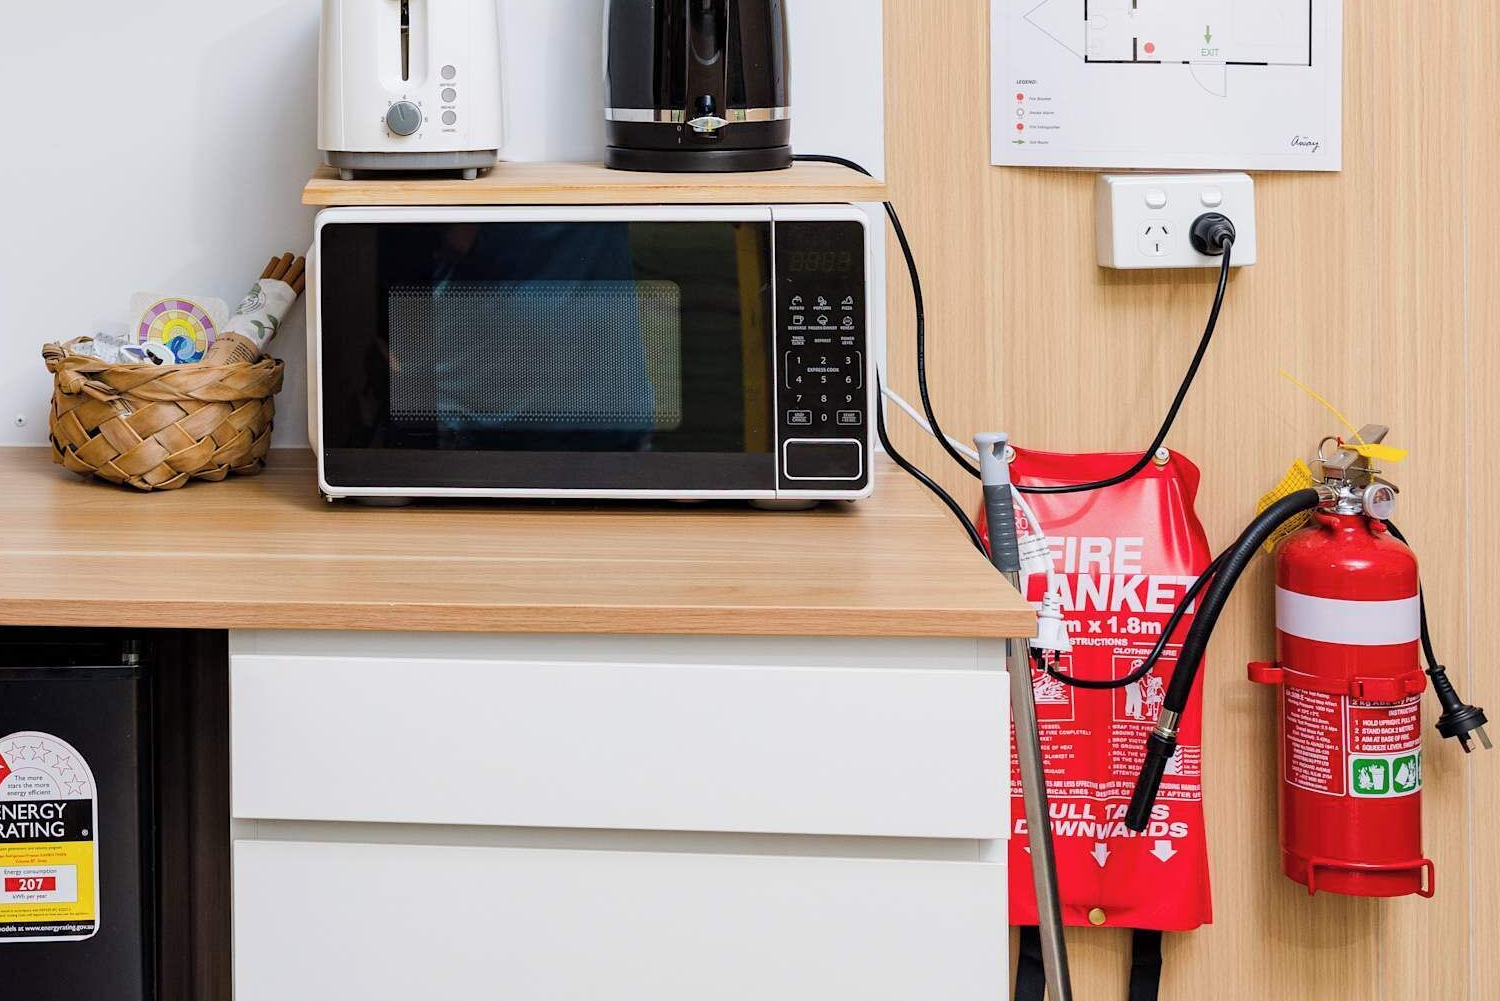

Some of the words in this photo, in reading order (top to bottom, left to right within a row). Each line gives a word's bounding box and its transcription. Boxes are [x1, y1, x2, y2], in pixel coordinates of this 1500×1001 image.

[1201, 48, 1220, 57] EXIT
[797, 356, 801, 364] 1
[821, 356, 827, 364] 2
[845, 356, 851, 365] 3
[796, 375, 802, 384] 4
[821, 375, 827, 383] 5
[845, 376, 852, 384] 6
[796, 394, 802, 402] 7
[845, 395, 852, 403] 9
[821, 413, 827, 422] 0
[1045, 536, 1144, 575] FIRE
[1021, 573, 1202, 615] LANKET
[1088, 619, 1102, 633] x
[1106, 617, 1162, 635] 1.8m
[1069, 637, 1128, 647] STRUCTIONS
[1113, 647, 1153, 656] CLOTHIN
[1167, 790, 1191, 798] AFTER
[1049, 803, 1097, 820] ULL
[1105, 803, 1170, 820] TAS
[1013, 818, 1189, 840] DWNWADS
[23, 868, 58, 876] consumption
[18, 878, 44, 891] 207
